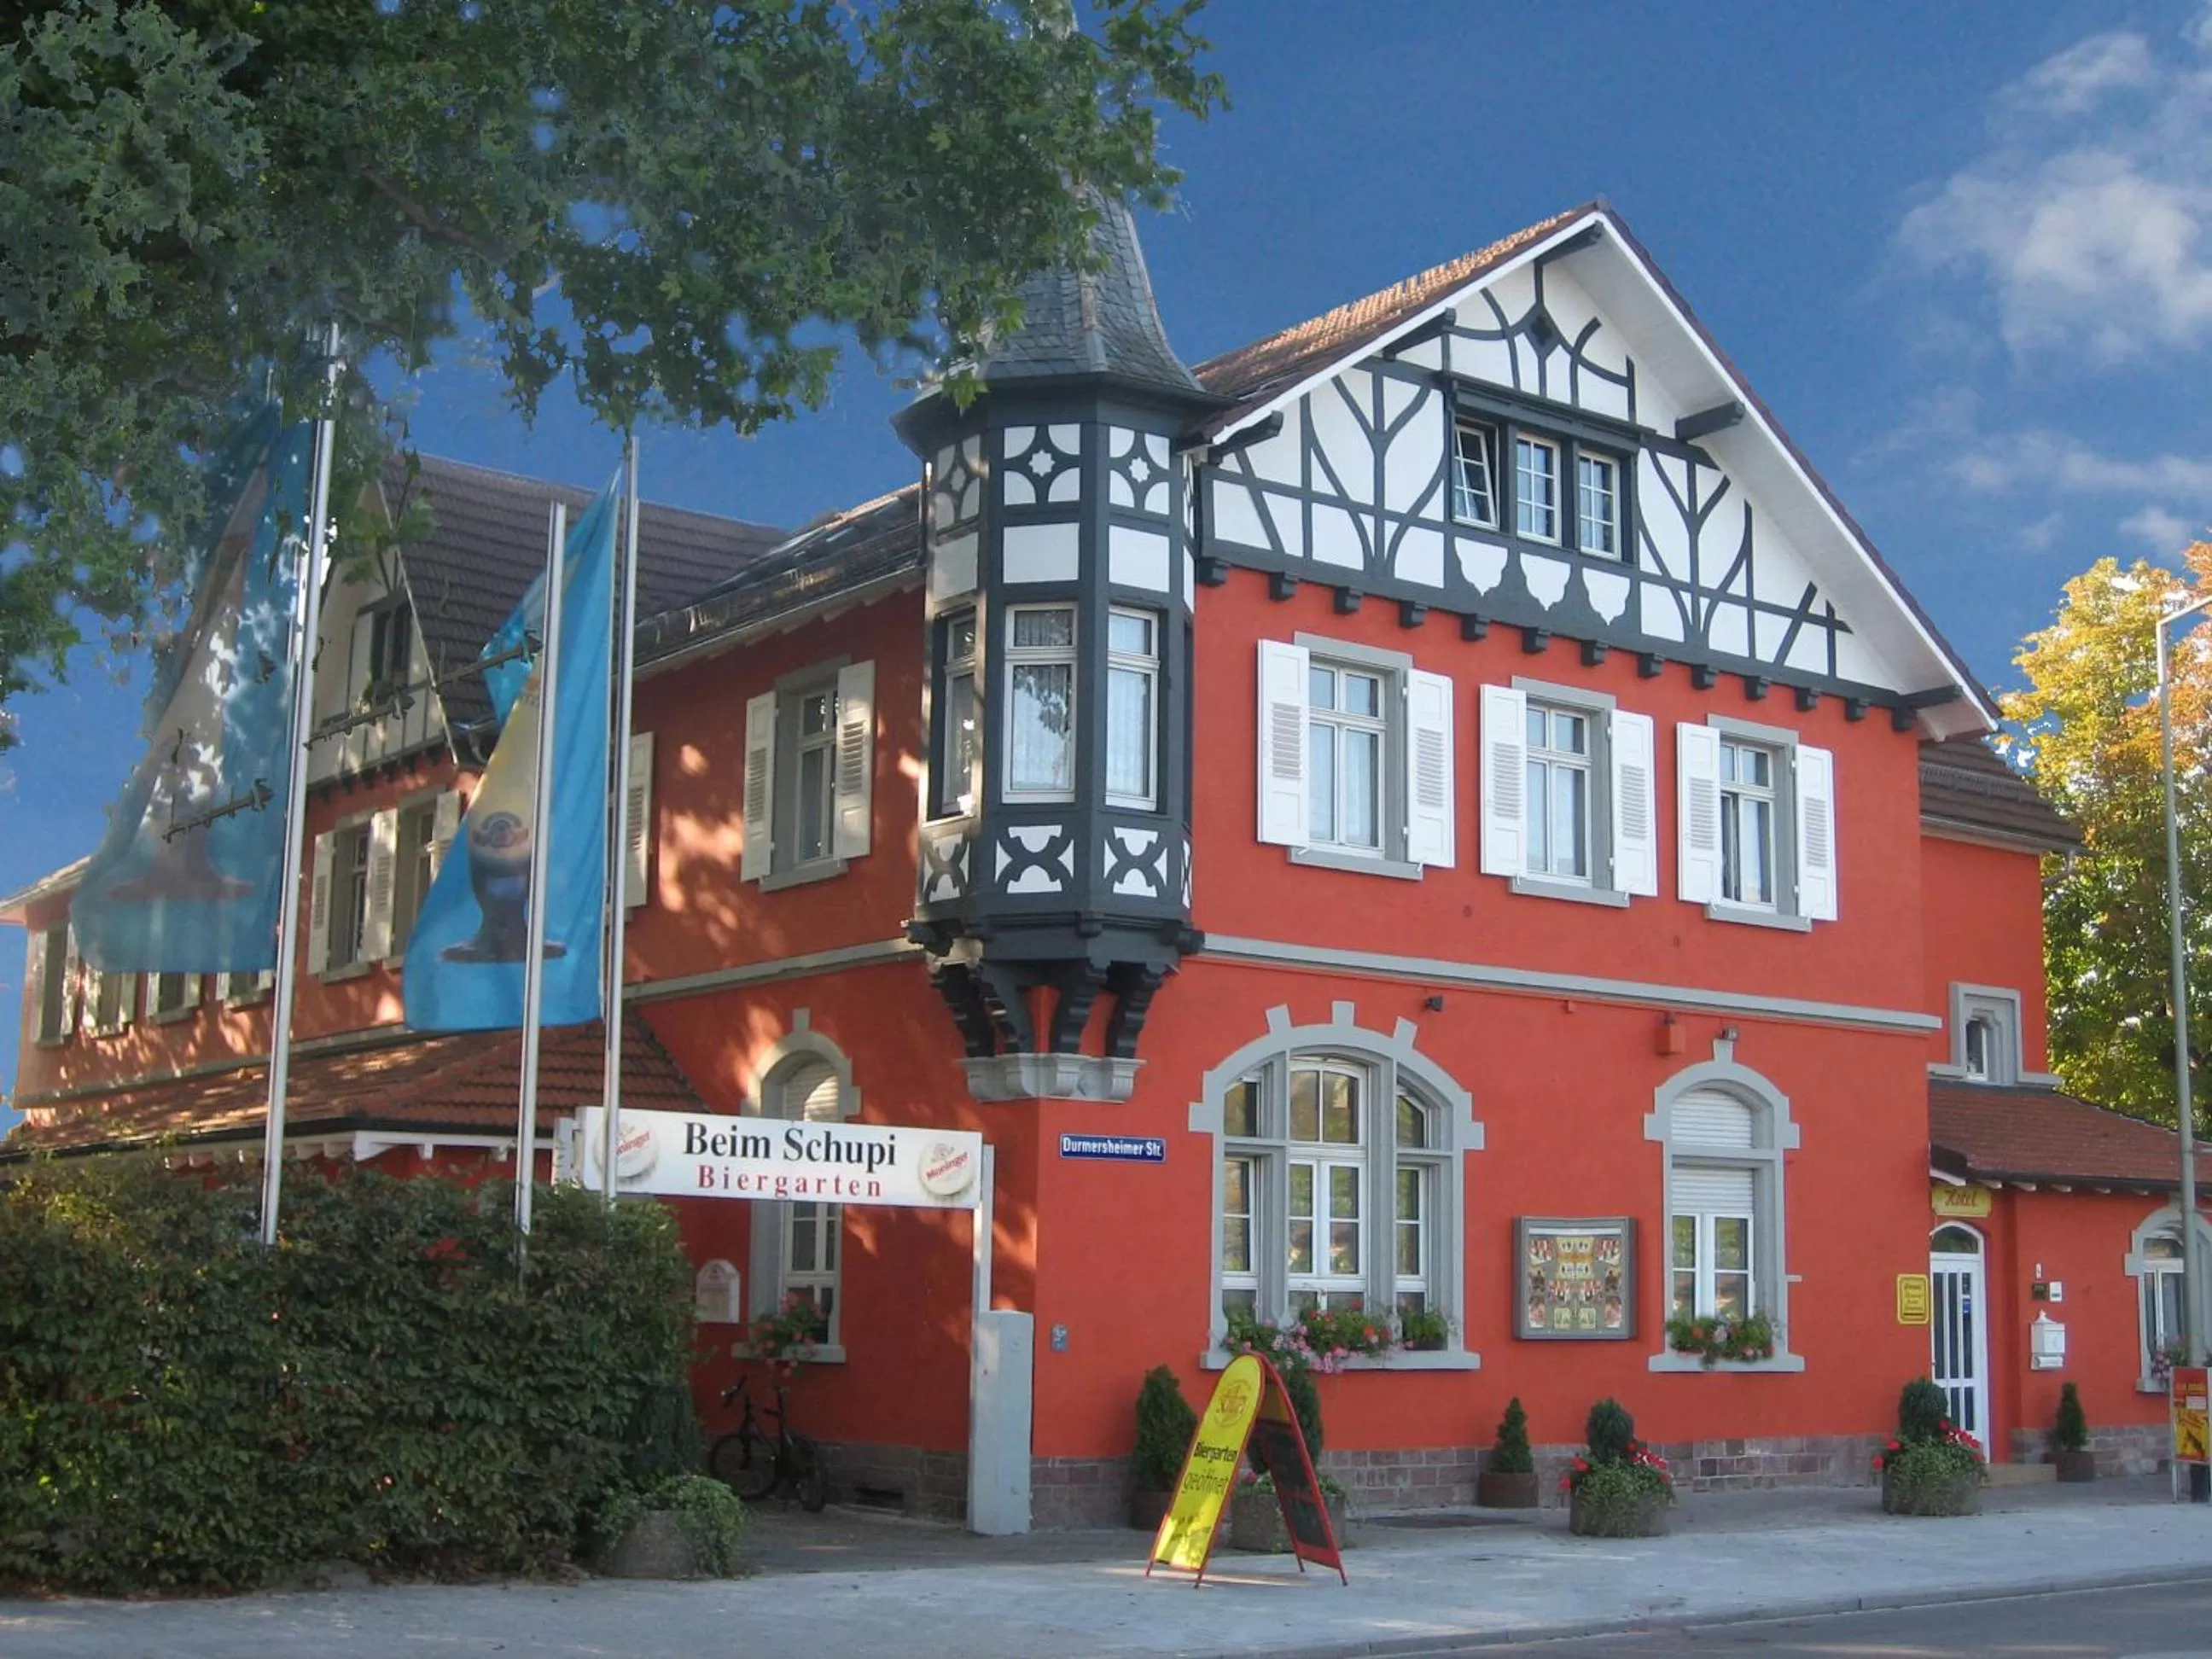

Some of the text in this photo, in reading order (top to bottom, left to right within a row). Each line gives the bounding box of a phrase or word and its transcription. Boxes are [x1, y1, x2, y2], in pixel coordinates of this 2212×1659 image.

[684, 1121, 897, 1174] Beim Schupi
[1062, 1136, 1144, 1155] Durmersheimer
[696, 1164, 882, 1199] Biergarten
[1193, 1441, 1238, 1464] Biergarten
